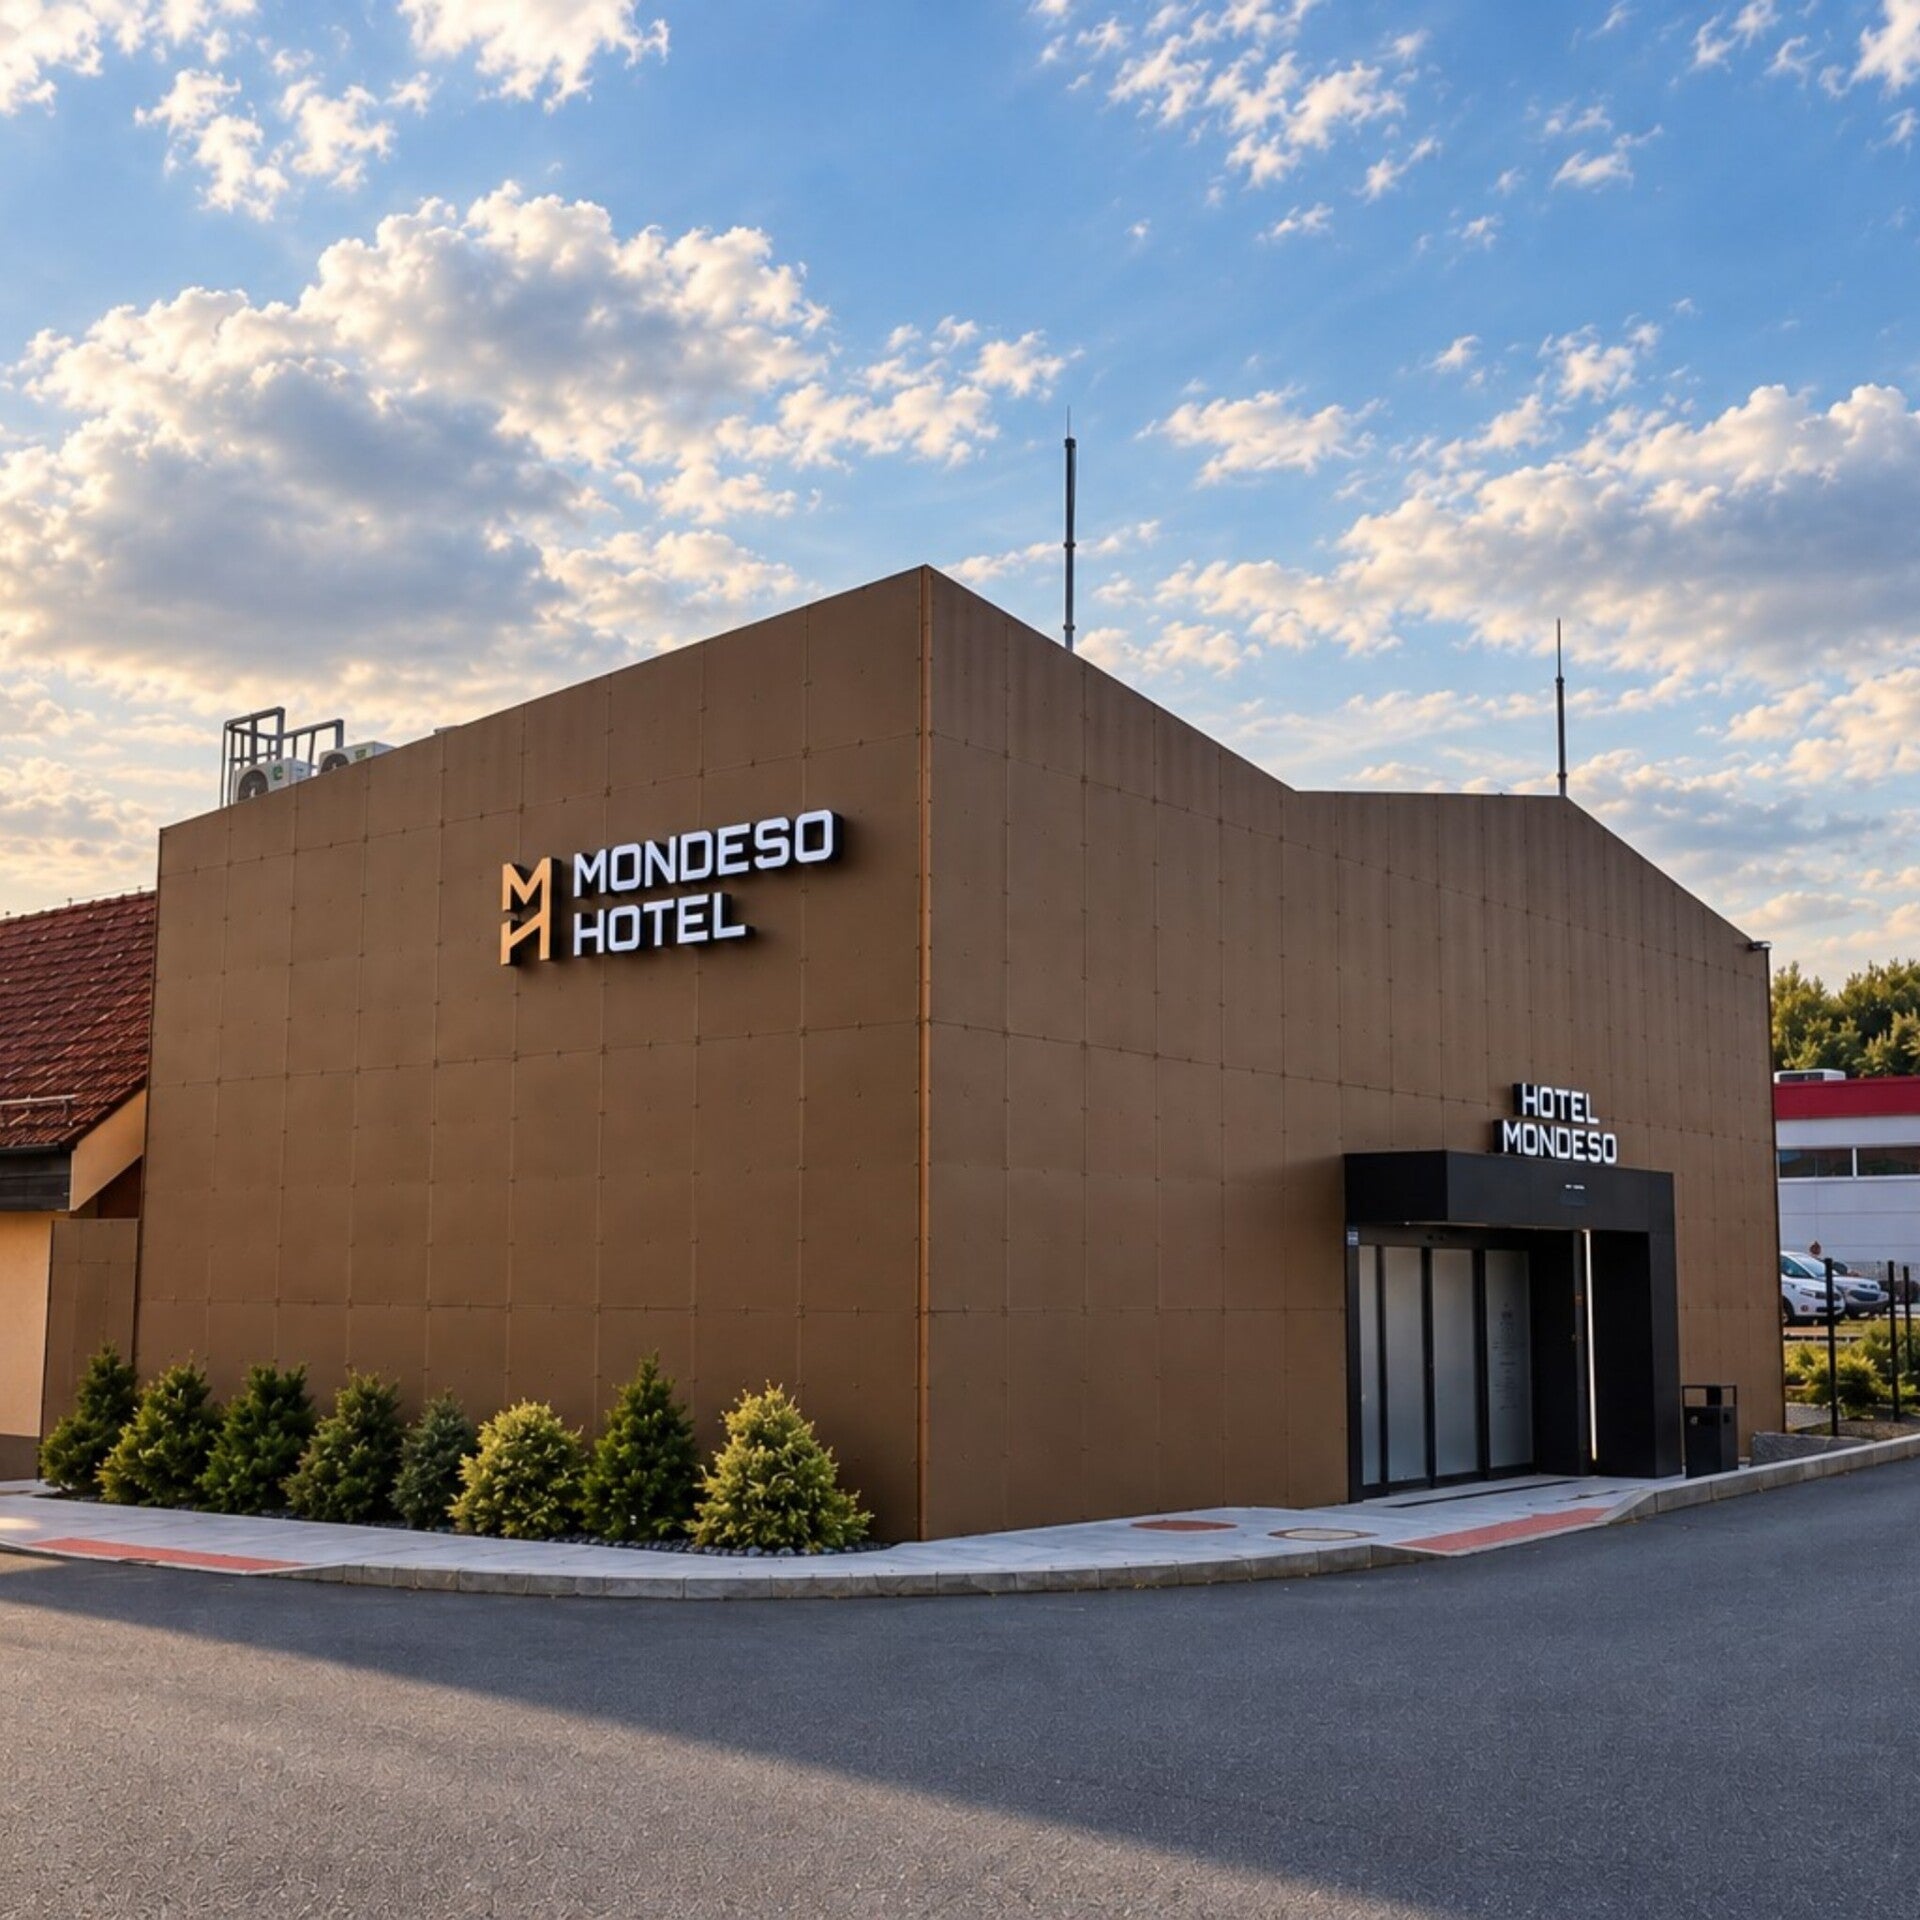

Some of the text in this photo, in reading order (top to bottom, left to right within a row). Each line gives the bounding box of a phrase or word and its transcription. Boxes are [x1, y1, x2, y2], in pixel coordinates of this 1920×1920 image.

[573, 809, 834, 897] MONDESO
[573, 891, 746, 956] HOTEL
[1522, 1082, 1600, 1125] HOTEL
[1502, 1119, 1618, 1165] MONDESO
